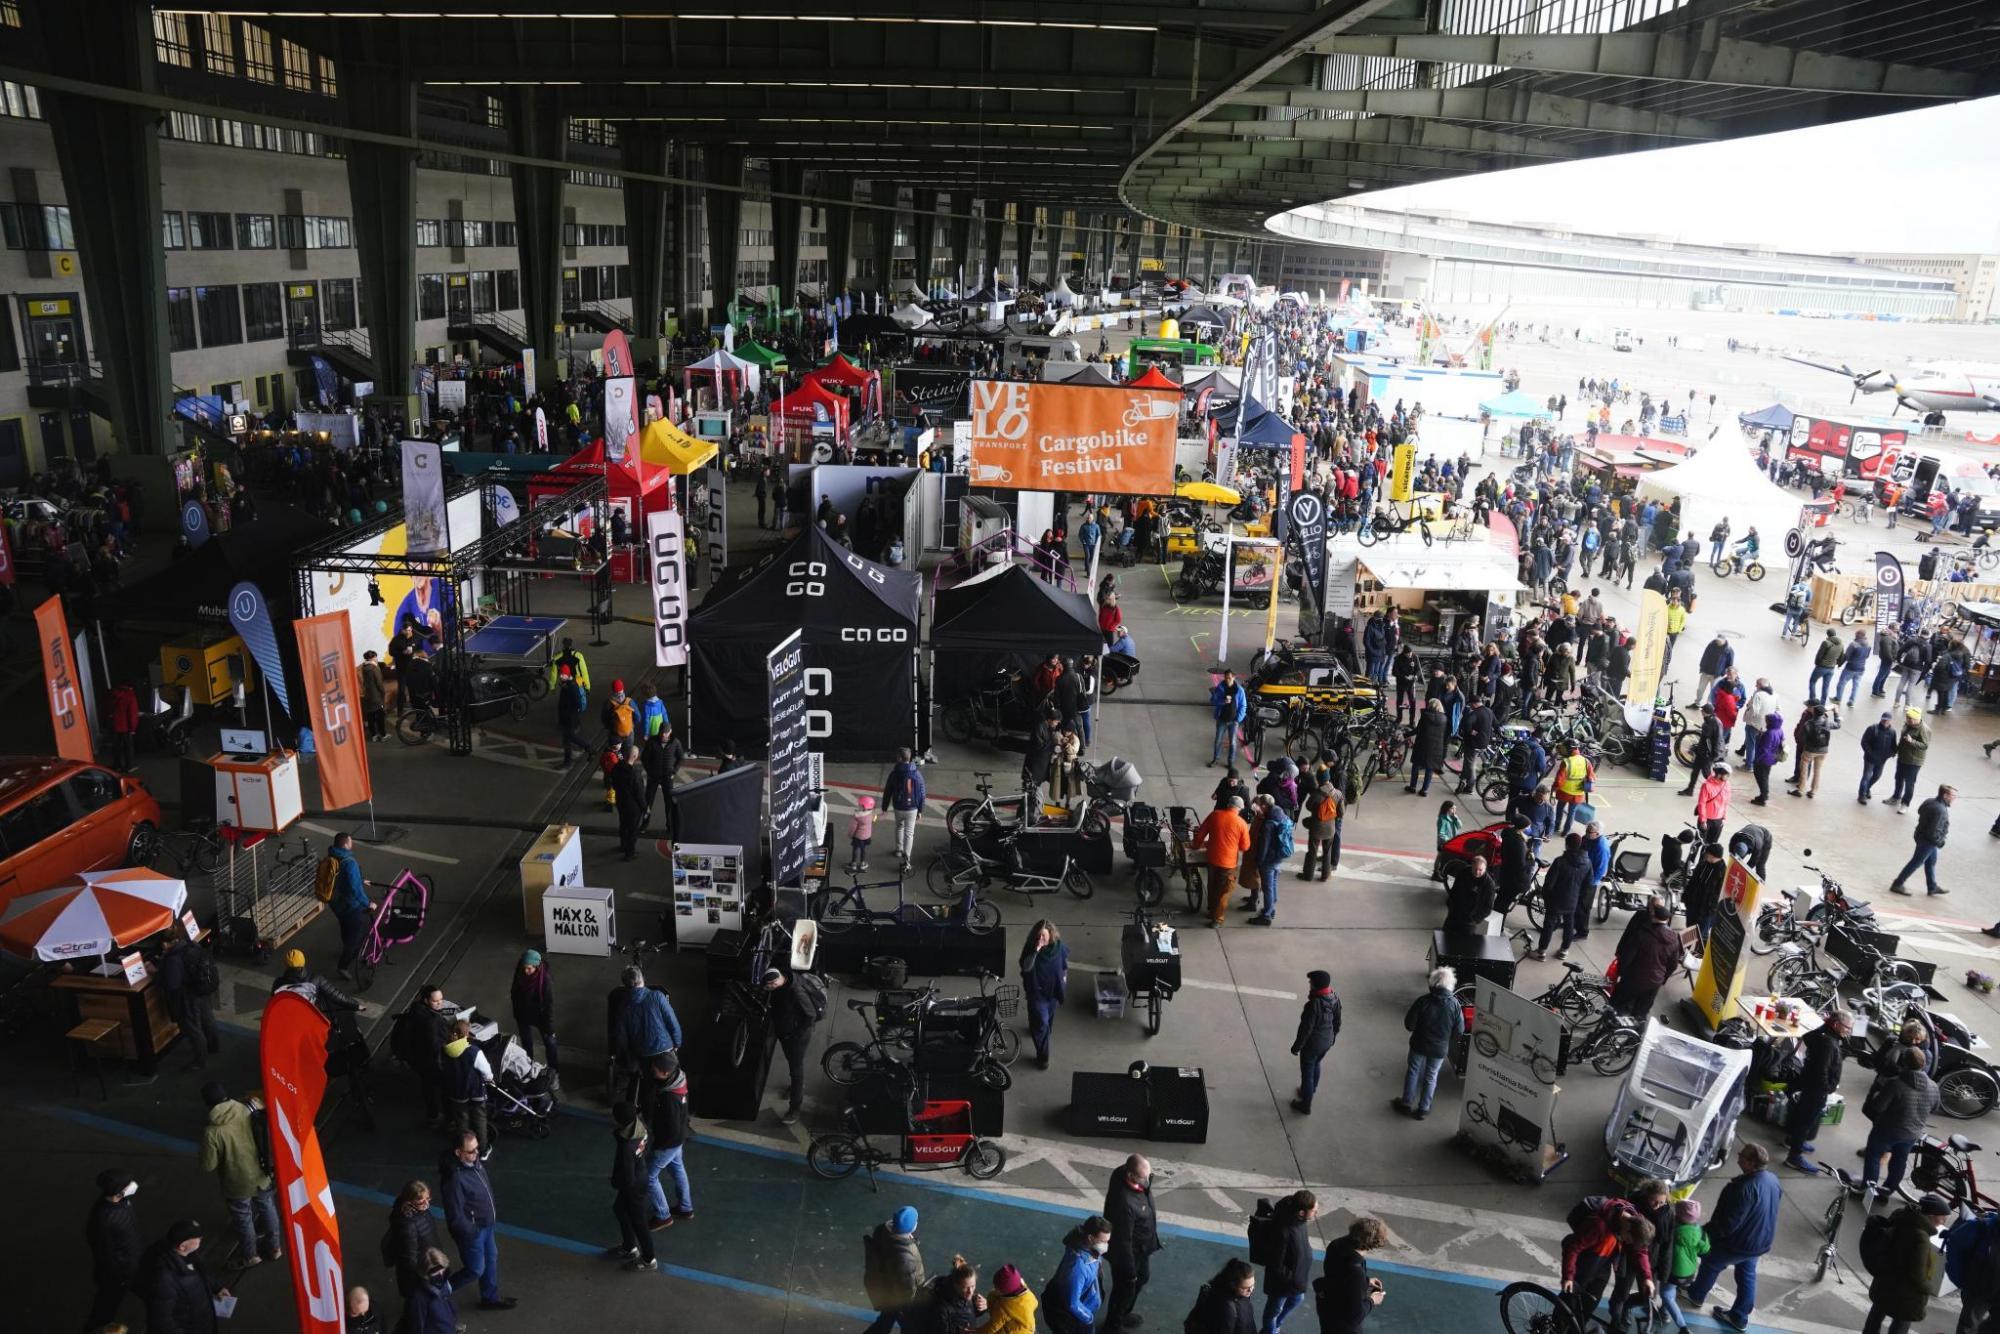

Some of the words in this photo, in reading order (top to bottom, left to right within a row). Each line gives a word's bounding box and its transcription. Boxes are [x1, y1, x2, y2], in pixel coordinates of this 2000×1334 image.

[60, 257, 71, 272] C
[974, 440, 1029, 450] TRANSPORT
[1039, 428, 1149, 453] Cargobike
[1040, 453, 1123, 477] Festival
[786, 581, 825, 597] GO
[198, 604, 228, 617] Mube
[876, 628, 907, 642] GO
[770, 649, 801, 681] VELOGUT
[585, 908, 597, 923] &
[52, 940, 98, 955] e2trail
[1477, 1062, 1518, 1089] christiania
[1517, 1082, 1539, 1099] bikes
[1097, 1115, 1128, 1124] VELOGUT
[1165, 1118, 1196, 1126] VELOGUT
[915, 1146, 962, 1154] VELOGUT
